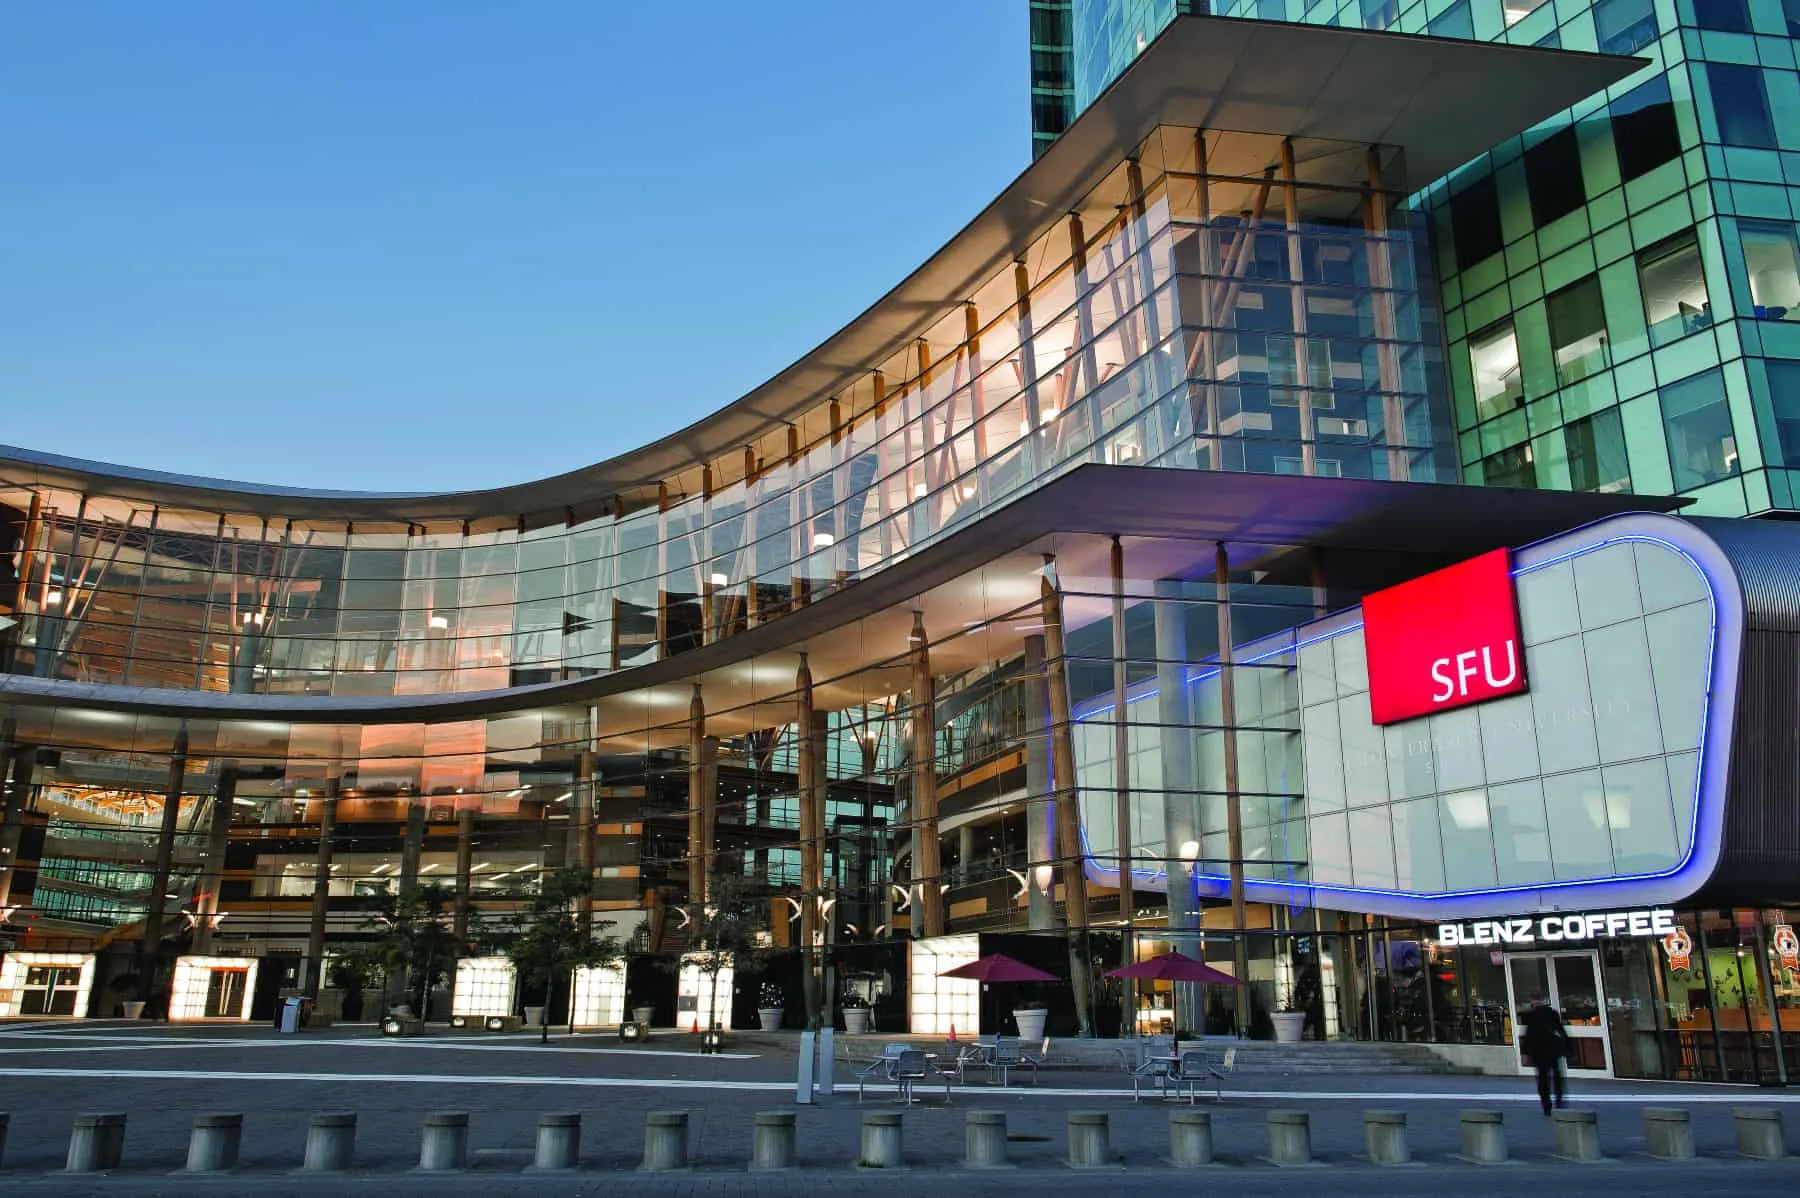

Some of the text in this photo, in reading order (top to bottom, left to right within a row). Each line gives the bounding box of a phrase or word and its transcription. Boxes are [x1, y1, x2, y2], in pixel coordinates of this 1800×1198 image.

[1431, 639, 1516, 702] SFU
[1438, 909, 1679, 946] BLENZ COFFEE
